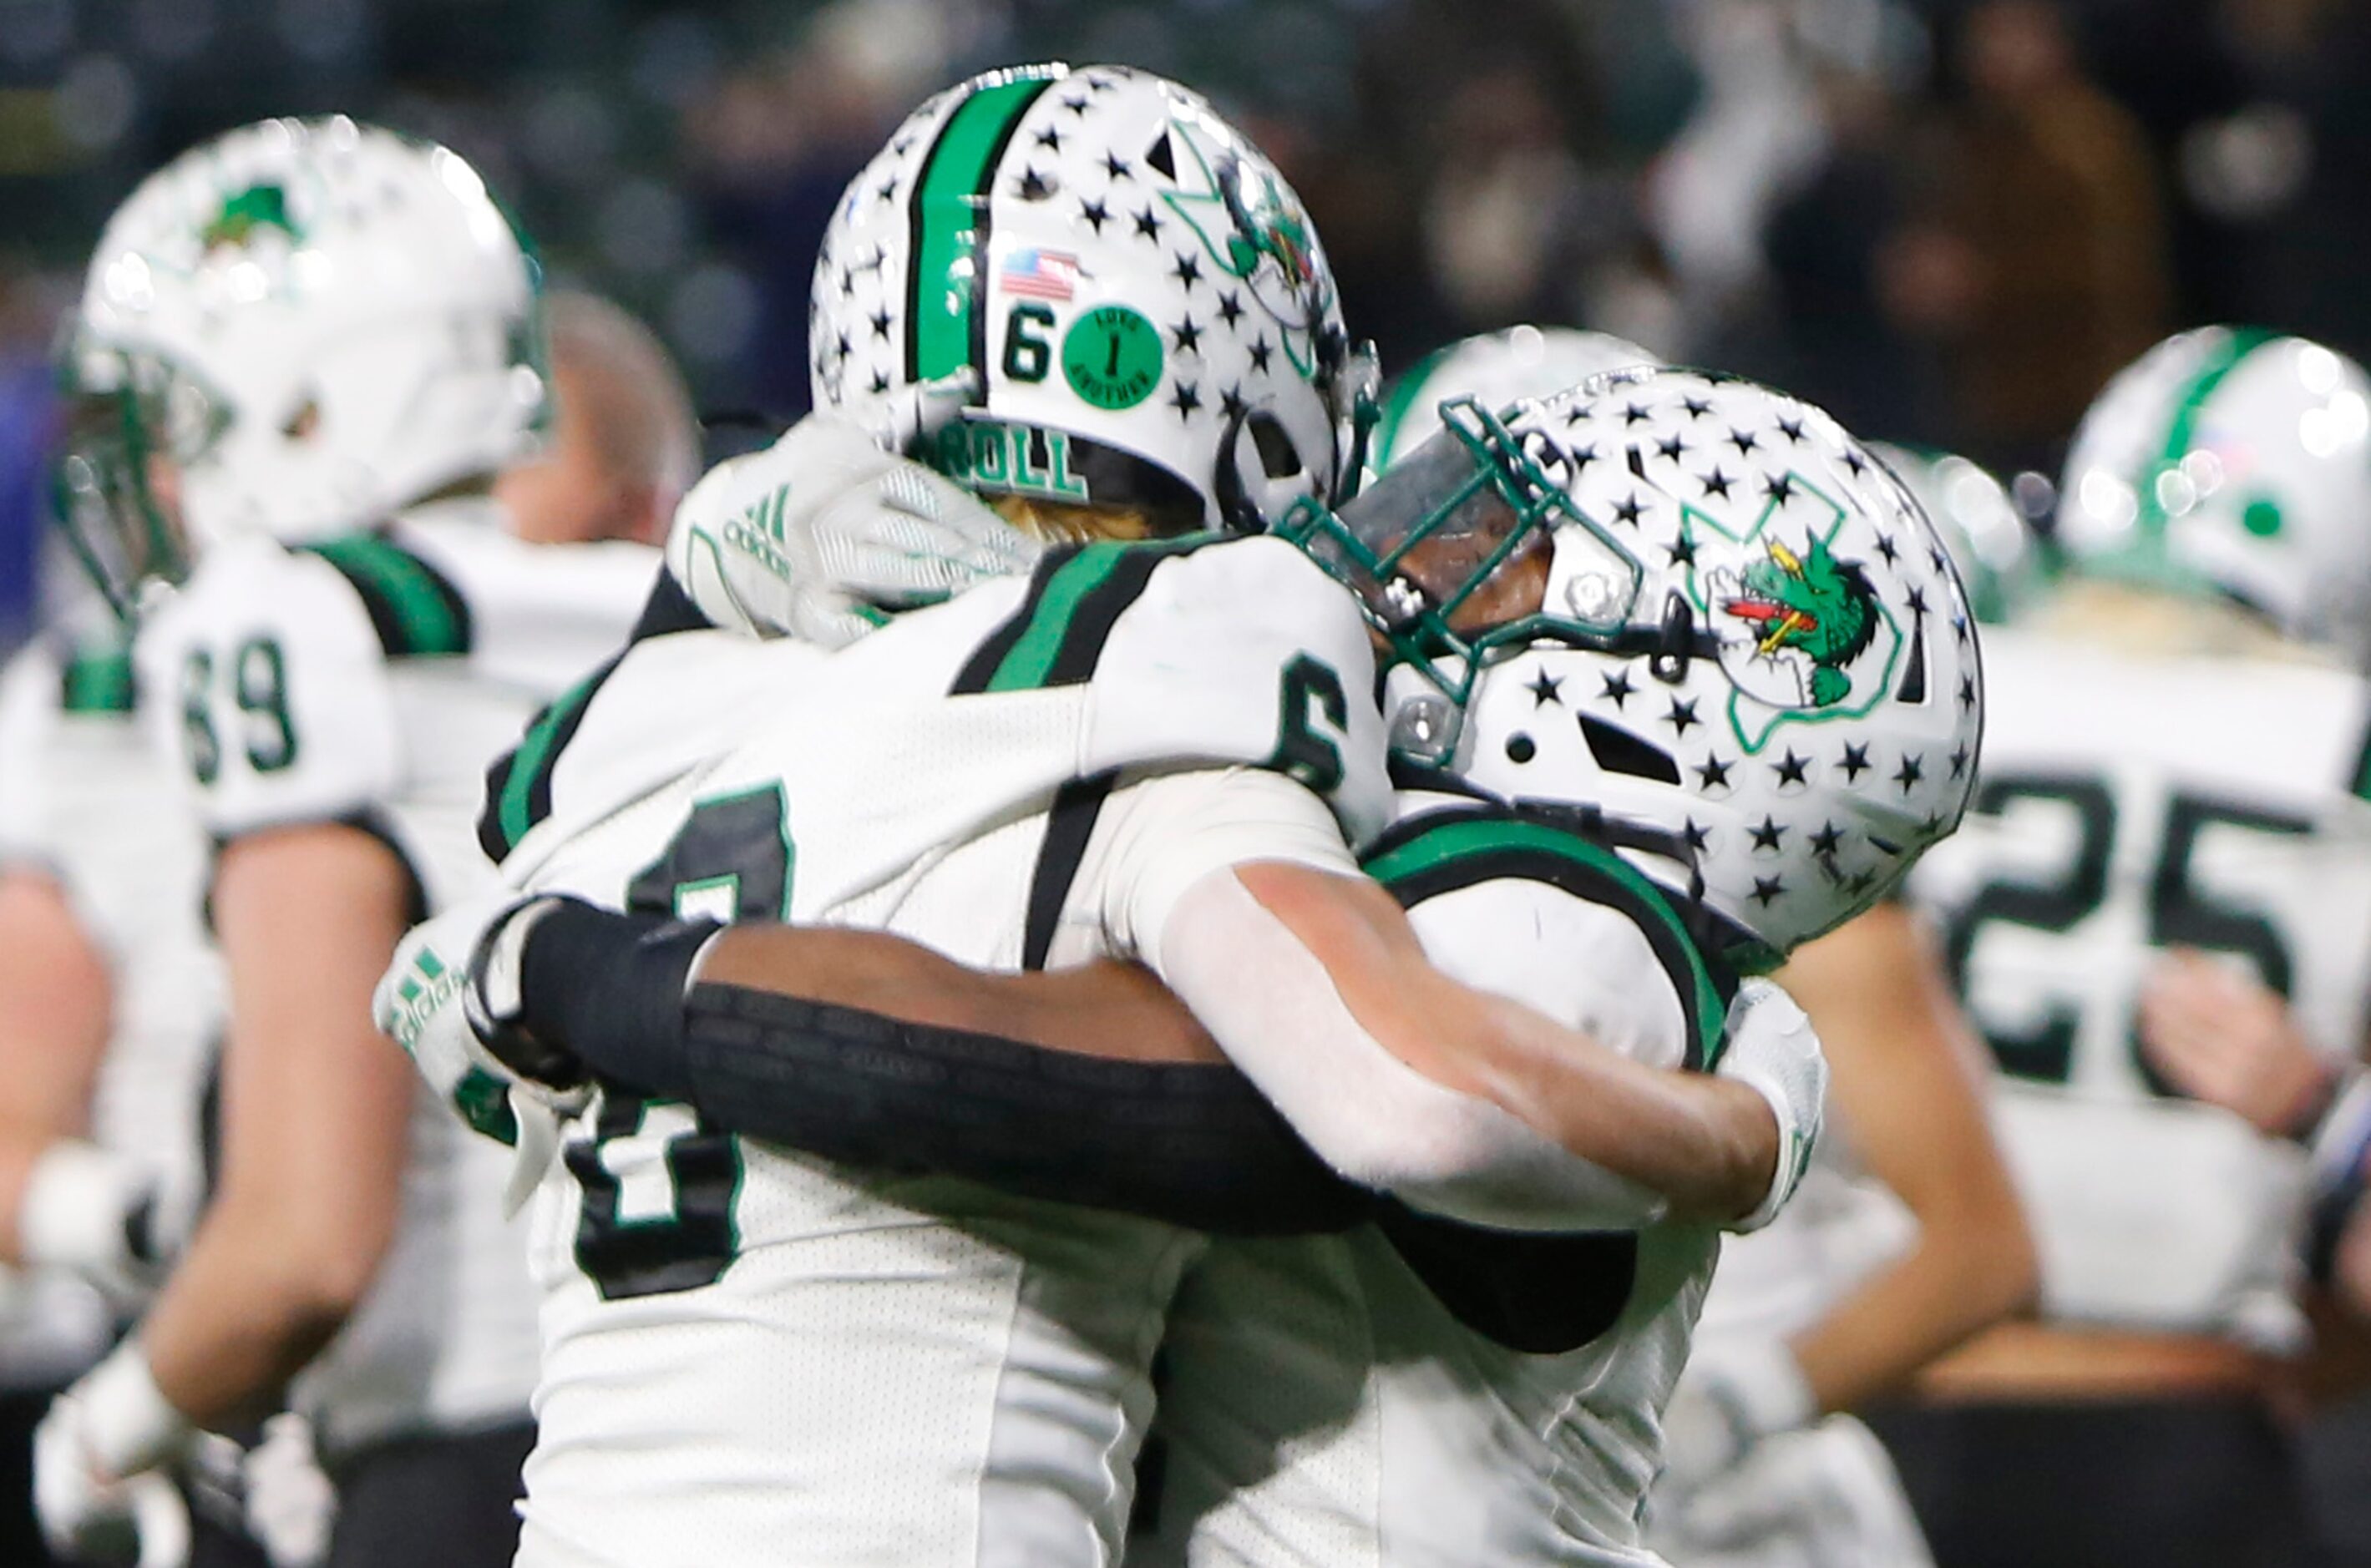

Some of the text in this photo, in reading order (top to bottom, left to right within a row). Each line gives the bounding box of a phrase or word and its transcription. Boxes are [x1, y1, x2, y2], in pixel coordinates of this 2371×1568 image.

[1003, 301, 1054, 382] 6
[1105, 332, 1121, 377] 1
[1269, 650, 1349, 793] 6
[1943, 770, 2318, 1099] 25
